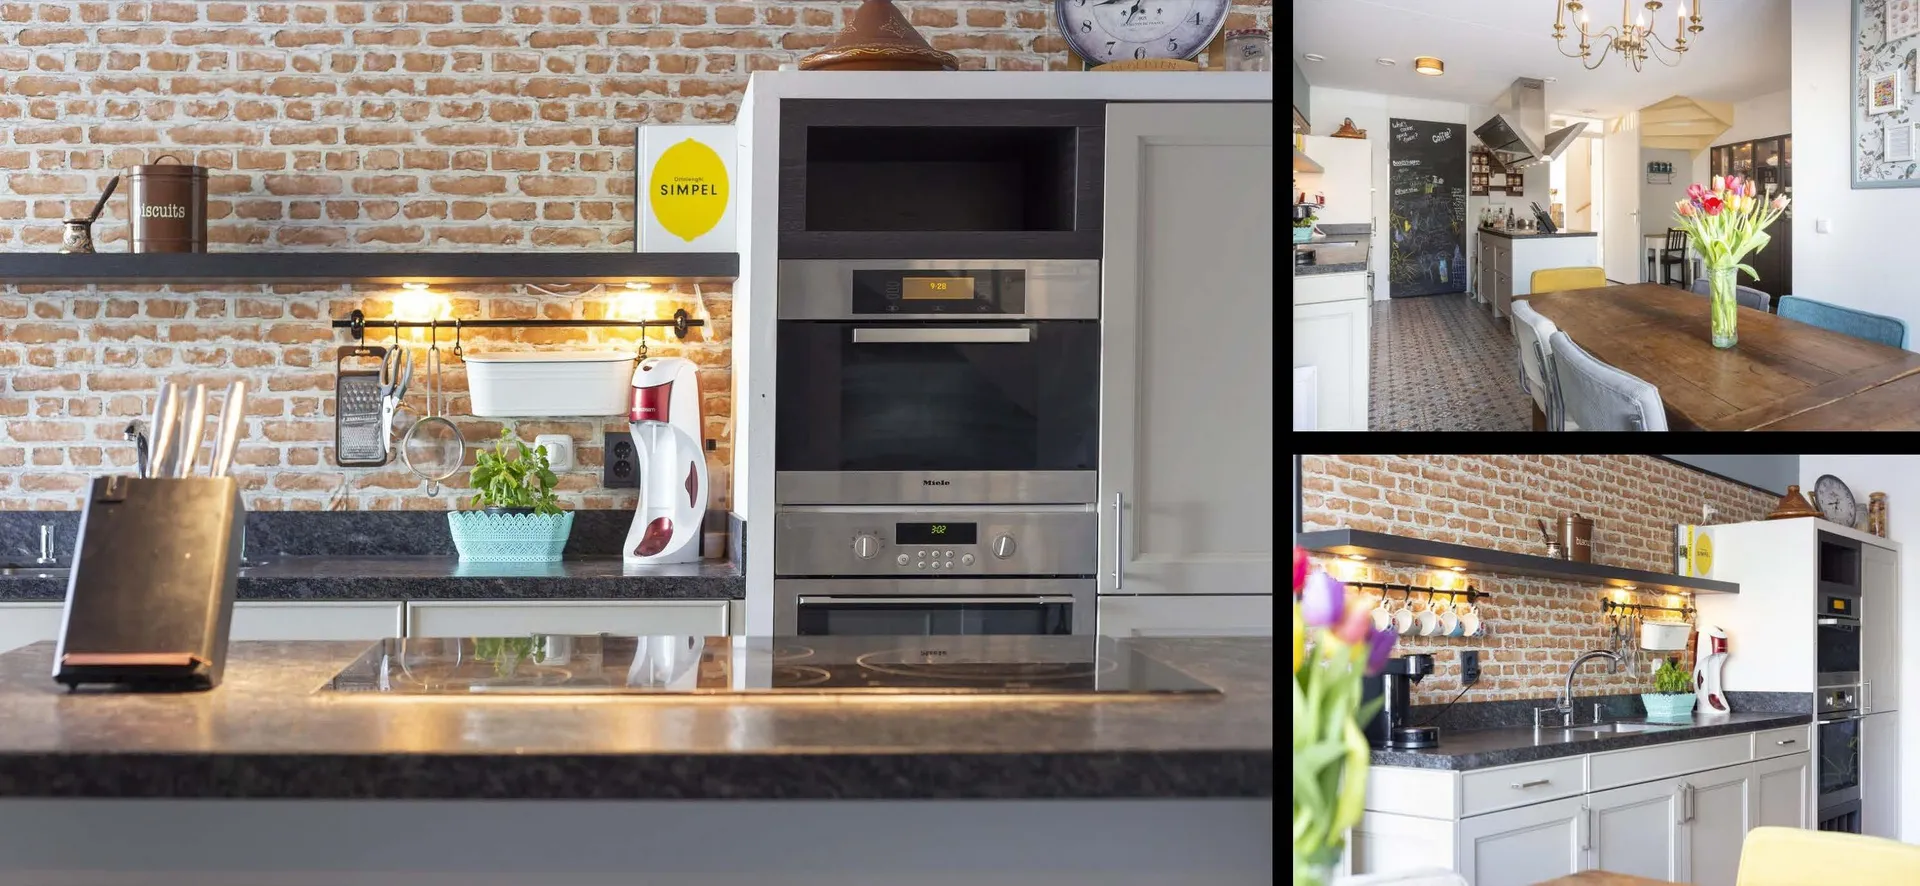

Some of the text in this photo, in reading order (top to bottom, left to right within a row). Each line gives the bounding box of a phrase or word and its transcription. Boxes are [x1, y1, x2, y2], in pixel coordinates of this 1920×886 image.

[1187, 12, 1204, 26] 4
[1081, 19, 1092, 34] 8
[1106, 41, 1115, 55] 7
[1167, 38, 1178, 51] 5
[1134, 46, 1146, 60] 6
[660, 184, 718, 196] SIMPEL
